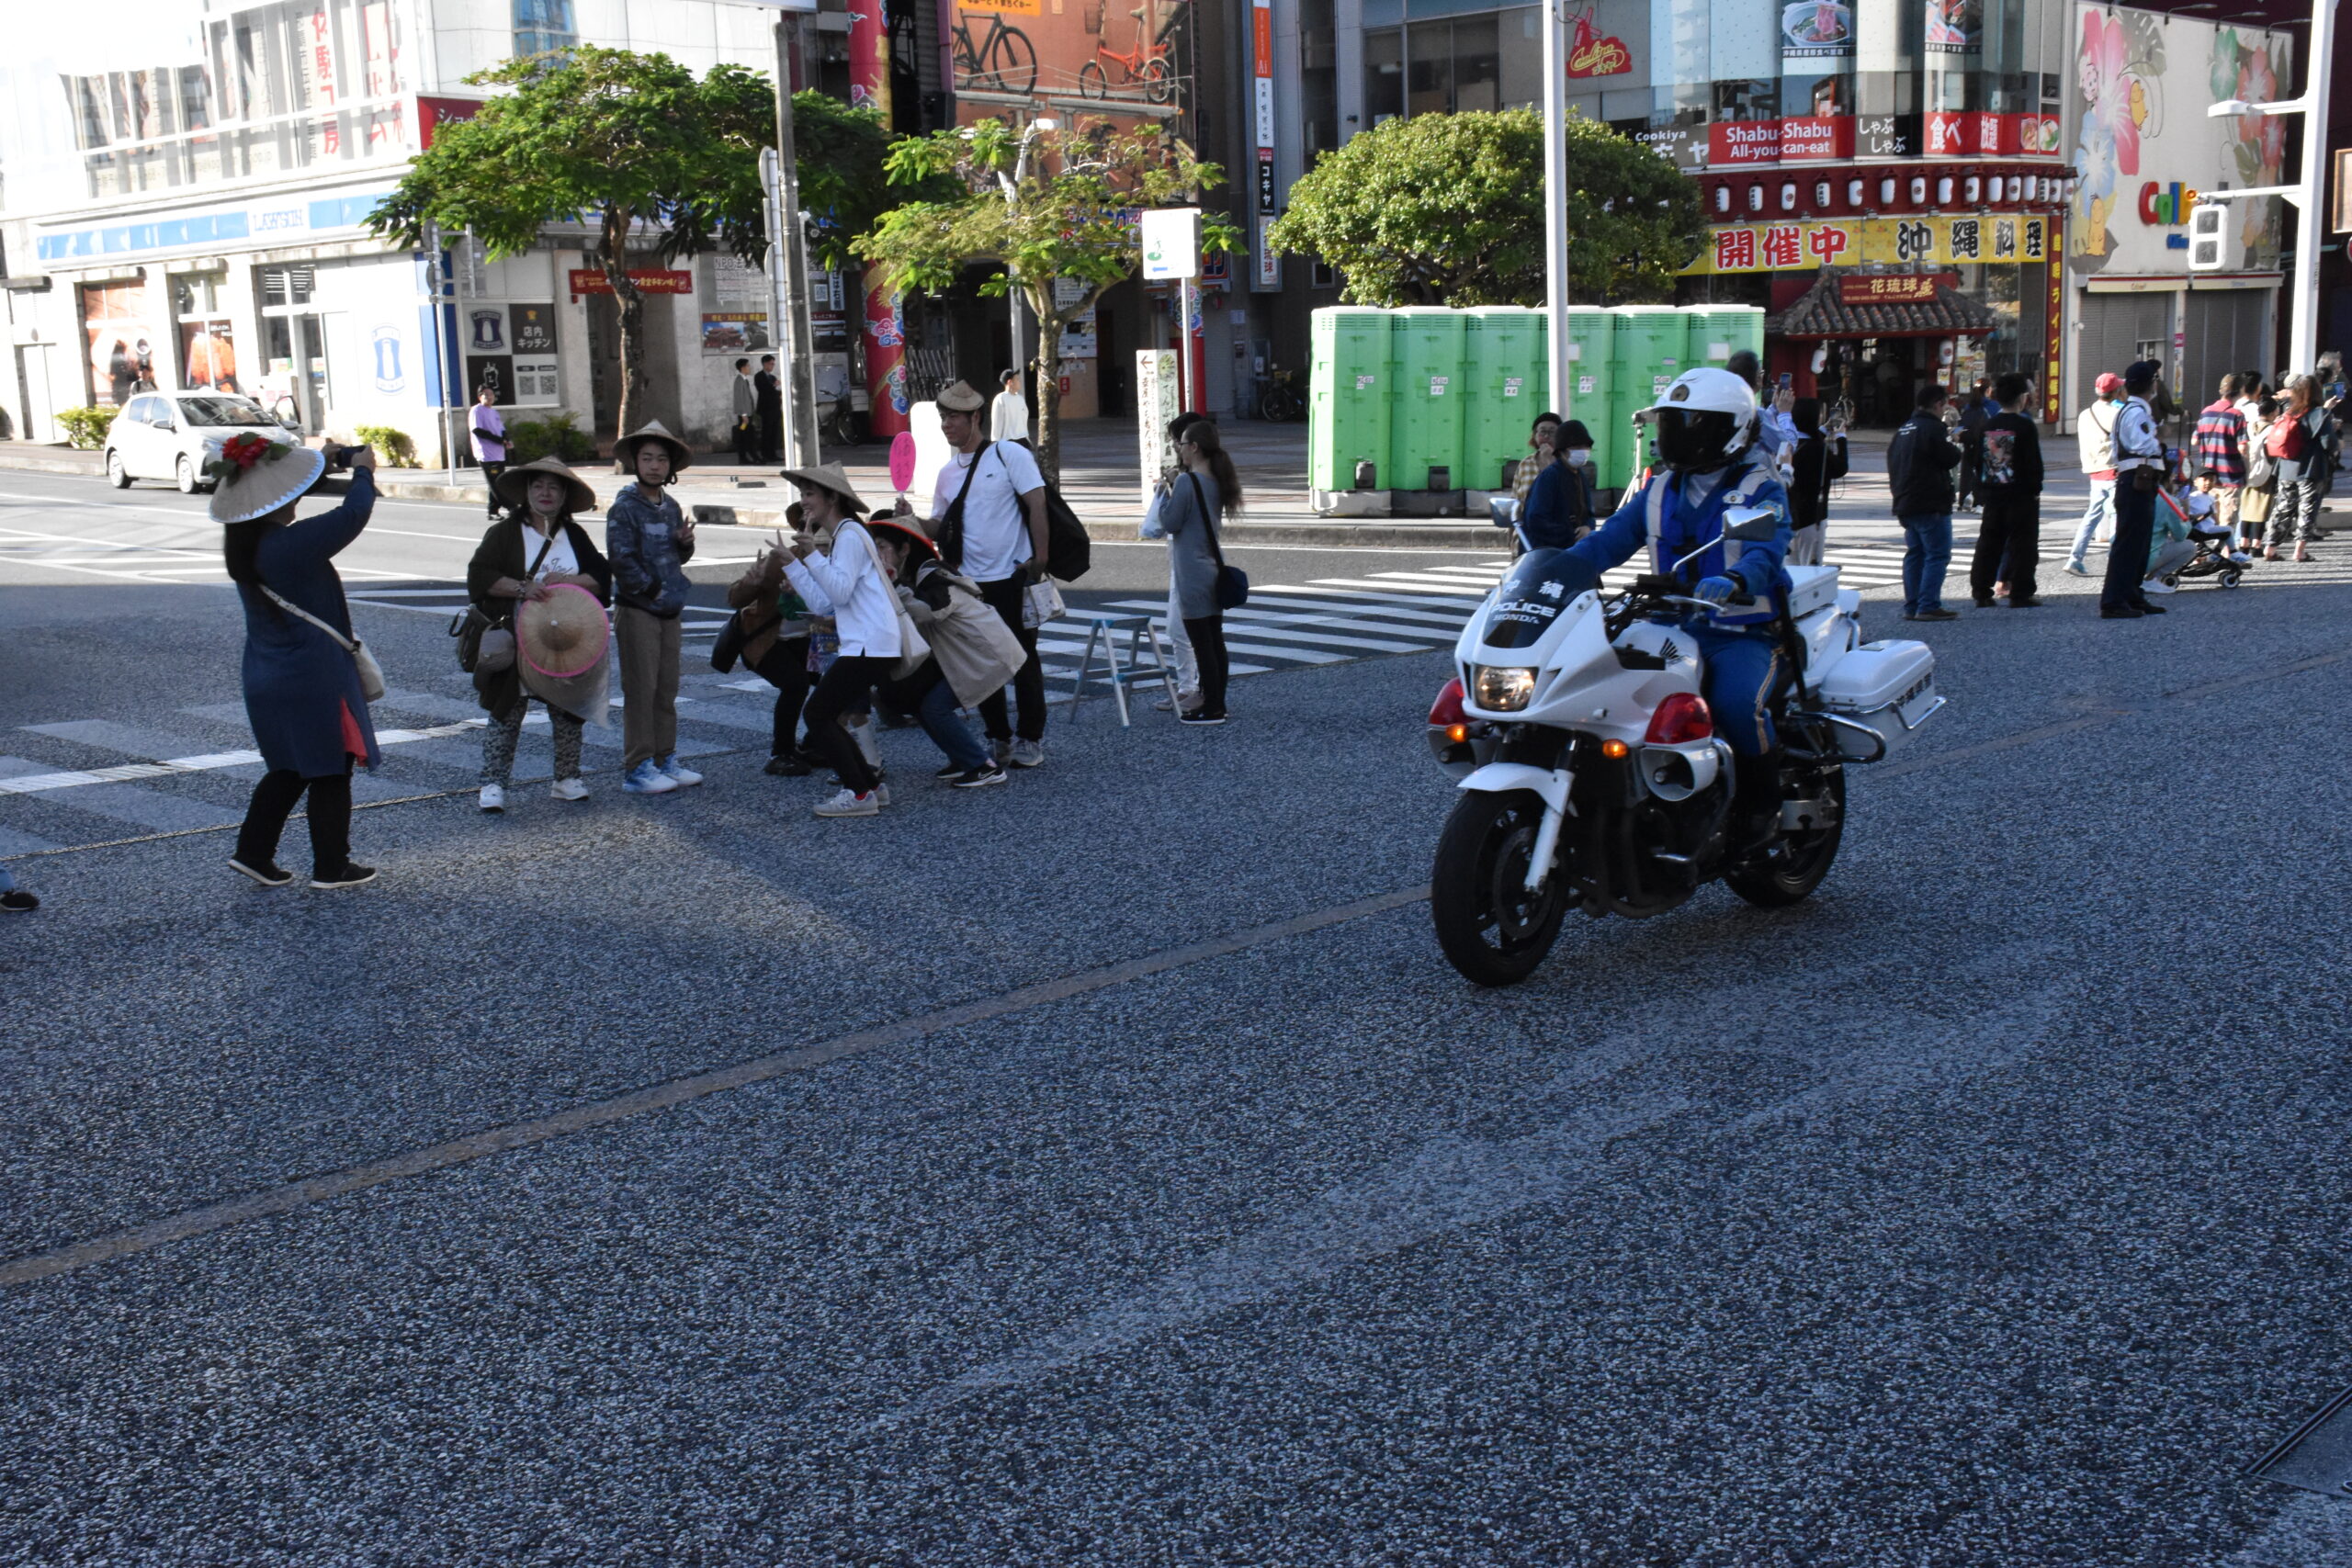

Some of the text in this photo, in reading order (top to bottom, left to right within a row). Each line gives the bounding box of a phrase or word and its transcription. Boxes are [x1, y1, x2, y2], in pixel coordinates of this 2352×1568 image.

[1635, 130, 1687, 141] Cookiya
[1725, 122, 1833, 143] Shabu-Shabu
[1859, 118, 1894, 135] しゃぶ
[1730, 141, 1830, 161] All-you-can-eat
[1871, 137, 1906, 153] しゃぶ
[1262, 166, 1271, 206] コキヤ
[253, 209, 304, 231] LAWSON
[1715, 220, 2041, 270] 開催中 沖縄料理
[523, 325, 543, 337] 店内
[516, 337, 551, 349] キッチン
[1490, 599, 1557, 618] POLICE
[1493, 613, 1541, 625] HONDA
